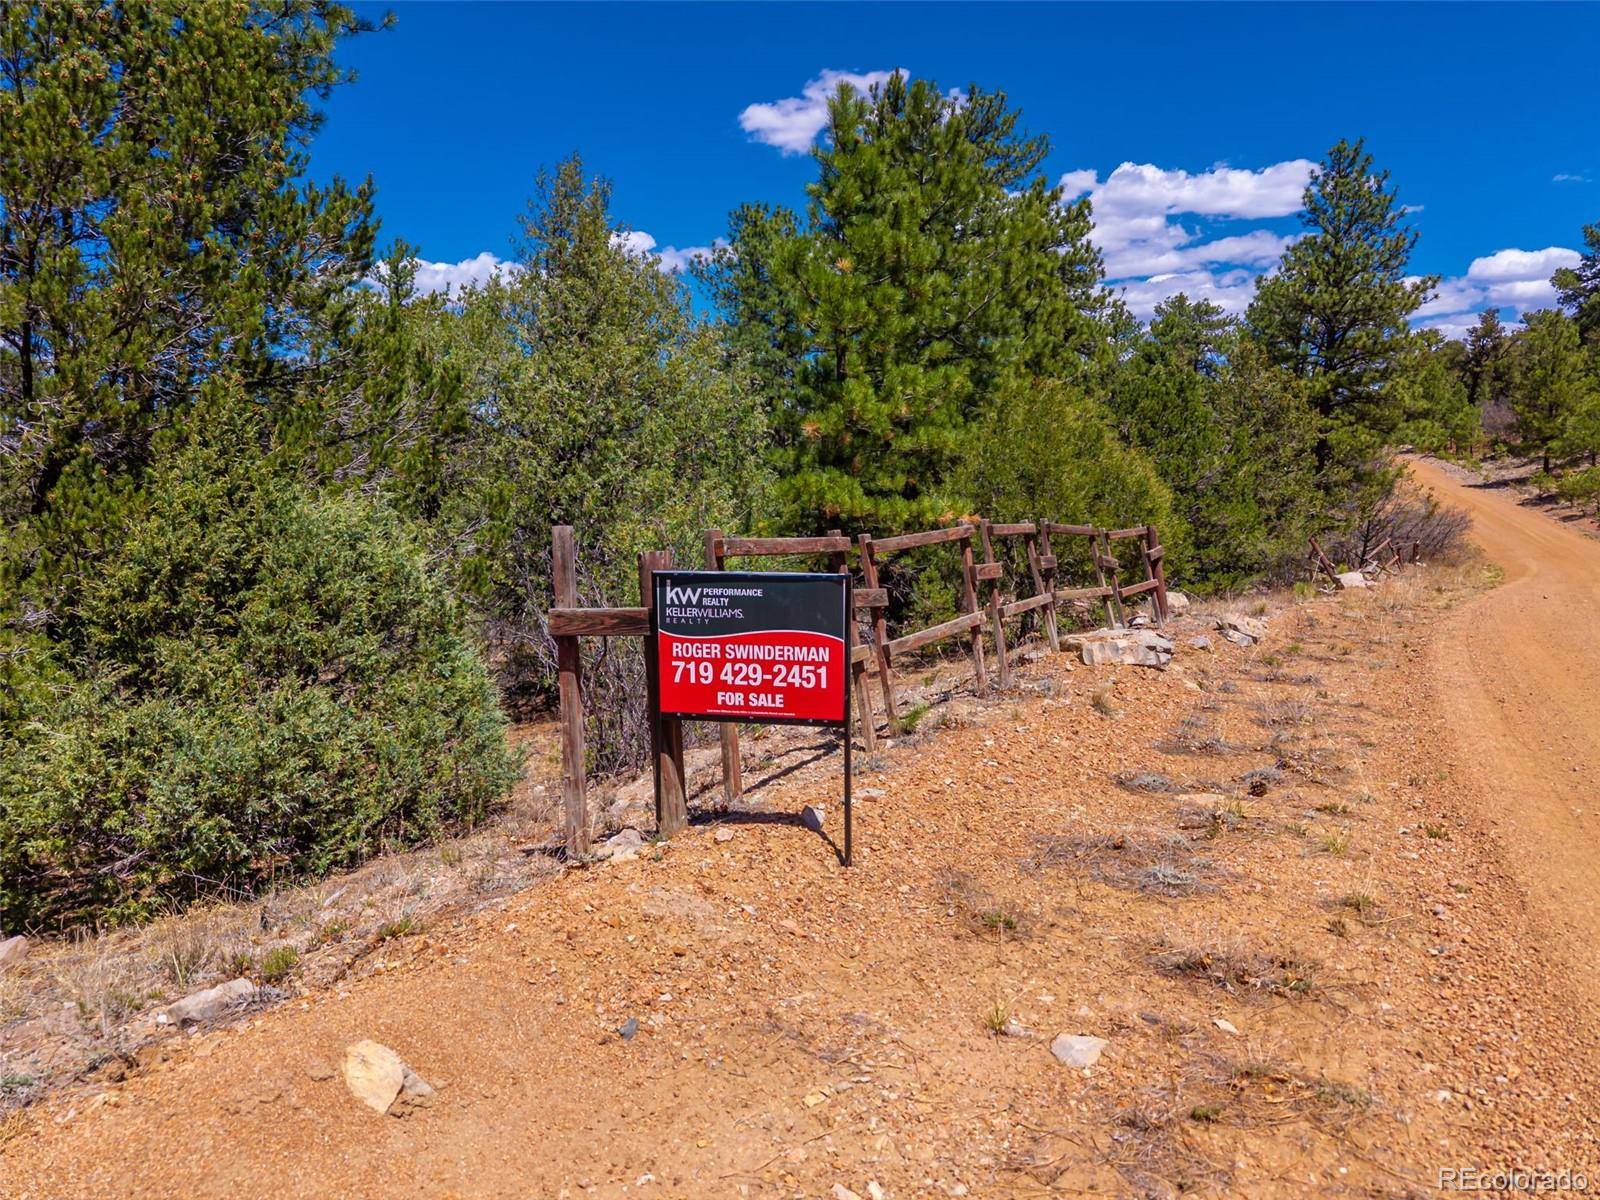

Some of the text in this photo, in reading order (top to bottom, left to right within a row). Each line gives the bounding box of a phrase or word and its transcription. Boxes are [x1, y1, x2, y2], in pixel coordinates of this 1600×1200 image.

[703, 588, 763, 596] PERFORMANCE
[702, 598, 728, 606] REALTY
[672, 643, 829, 662] ROGER SWINDERMAN
[672, 661, 827, 689] 719 429-2451
[717, 692, 784, 708] FOR SALE
